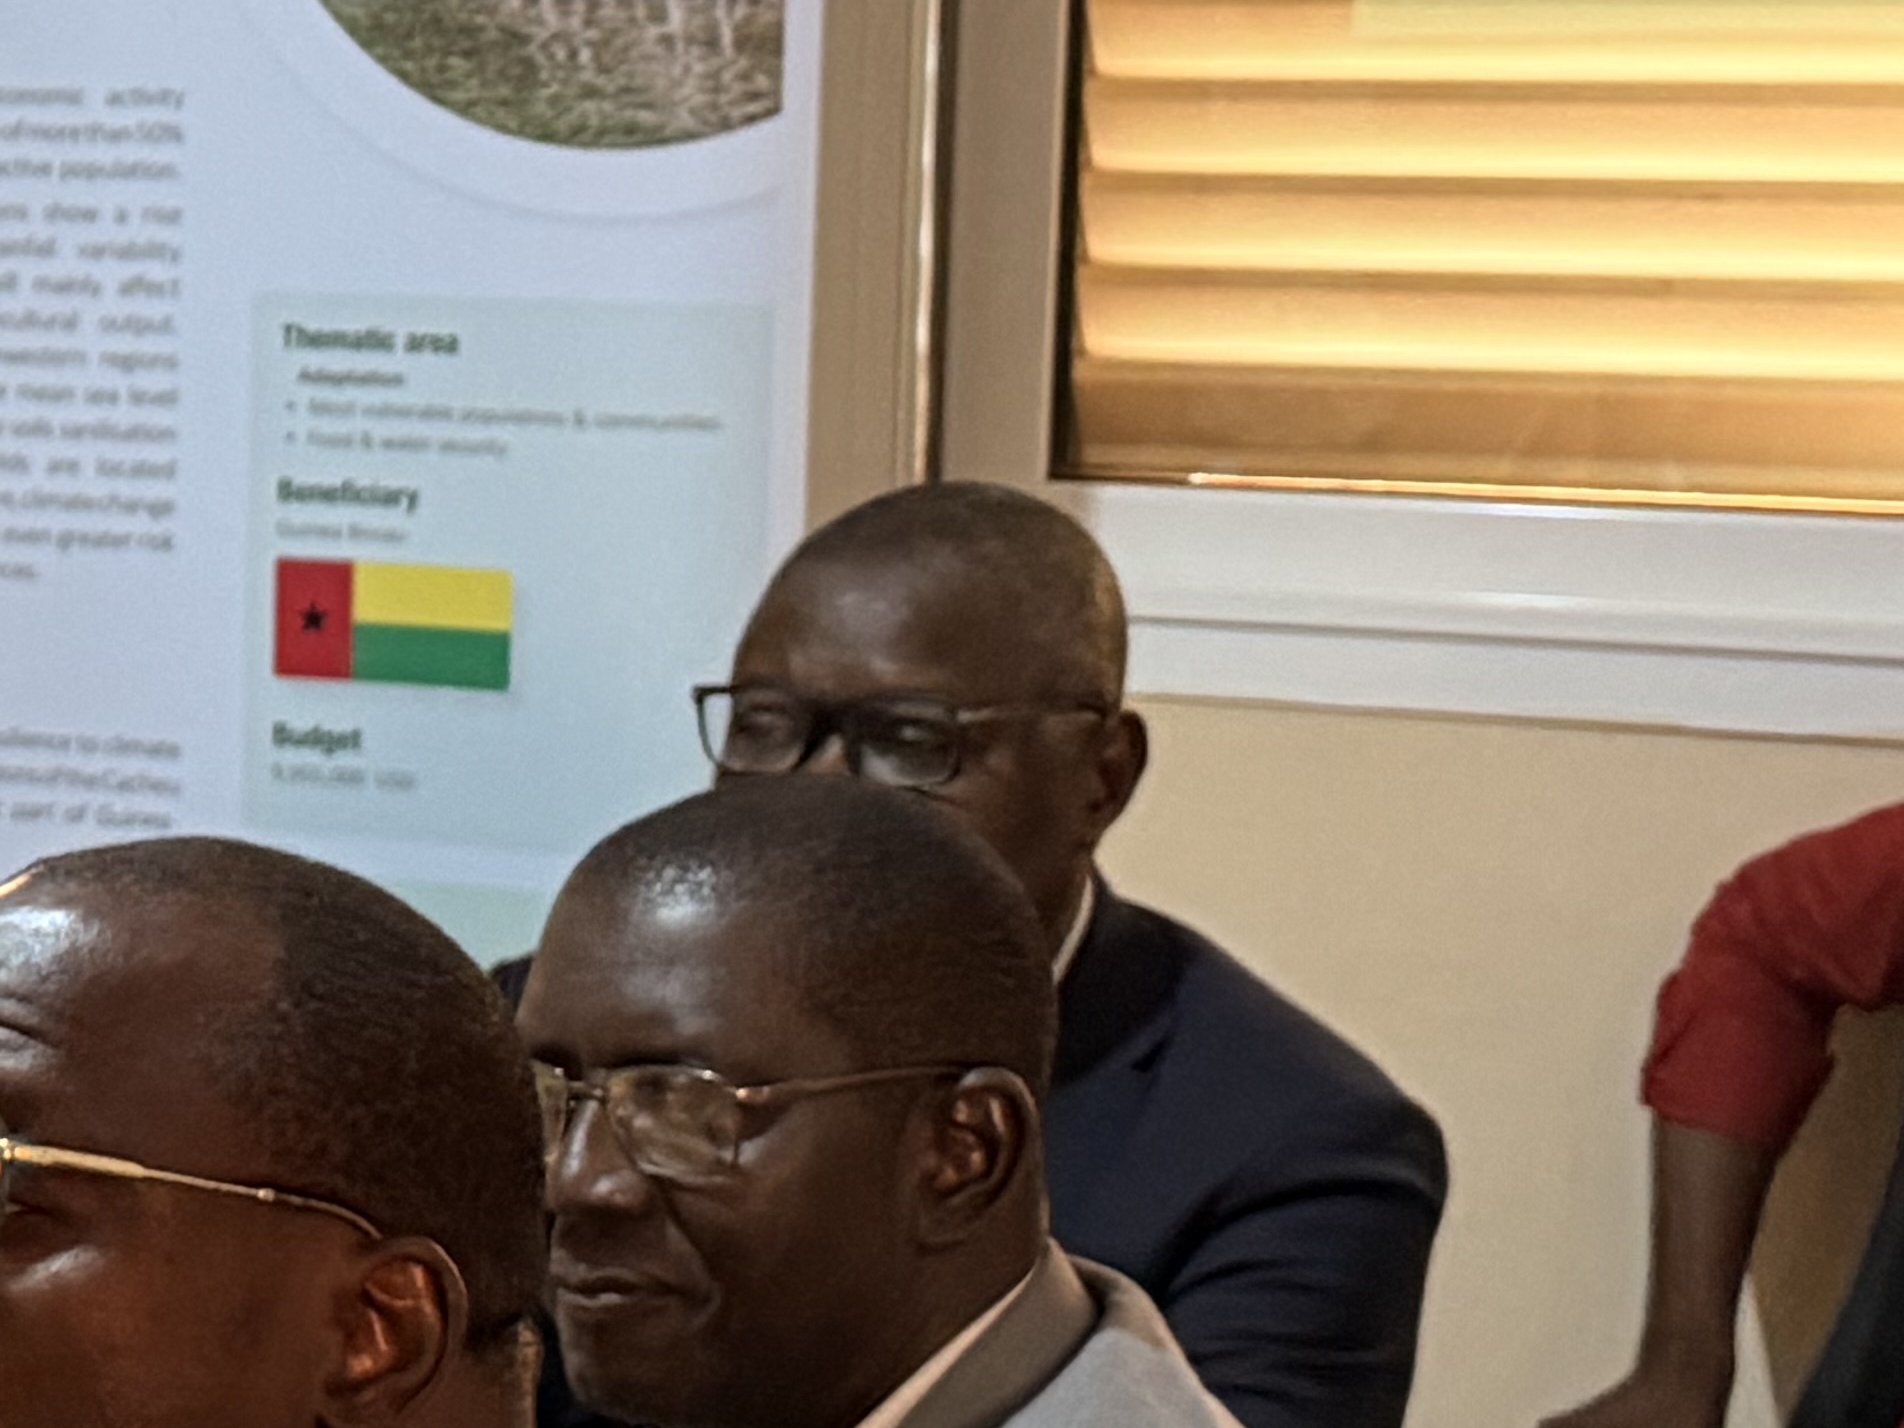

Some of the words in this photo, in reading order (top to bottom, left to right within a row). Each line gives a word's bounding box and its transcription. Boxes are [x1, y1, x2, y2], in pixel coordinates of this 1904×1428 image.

[283, 323, 396, 354] Thematic
[403, 332, 460, 356] area
[276, 477, 420, 514] Beneficiary
[271, 721, 362, 757] Budget
